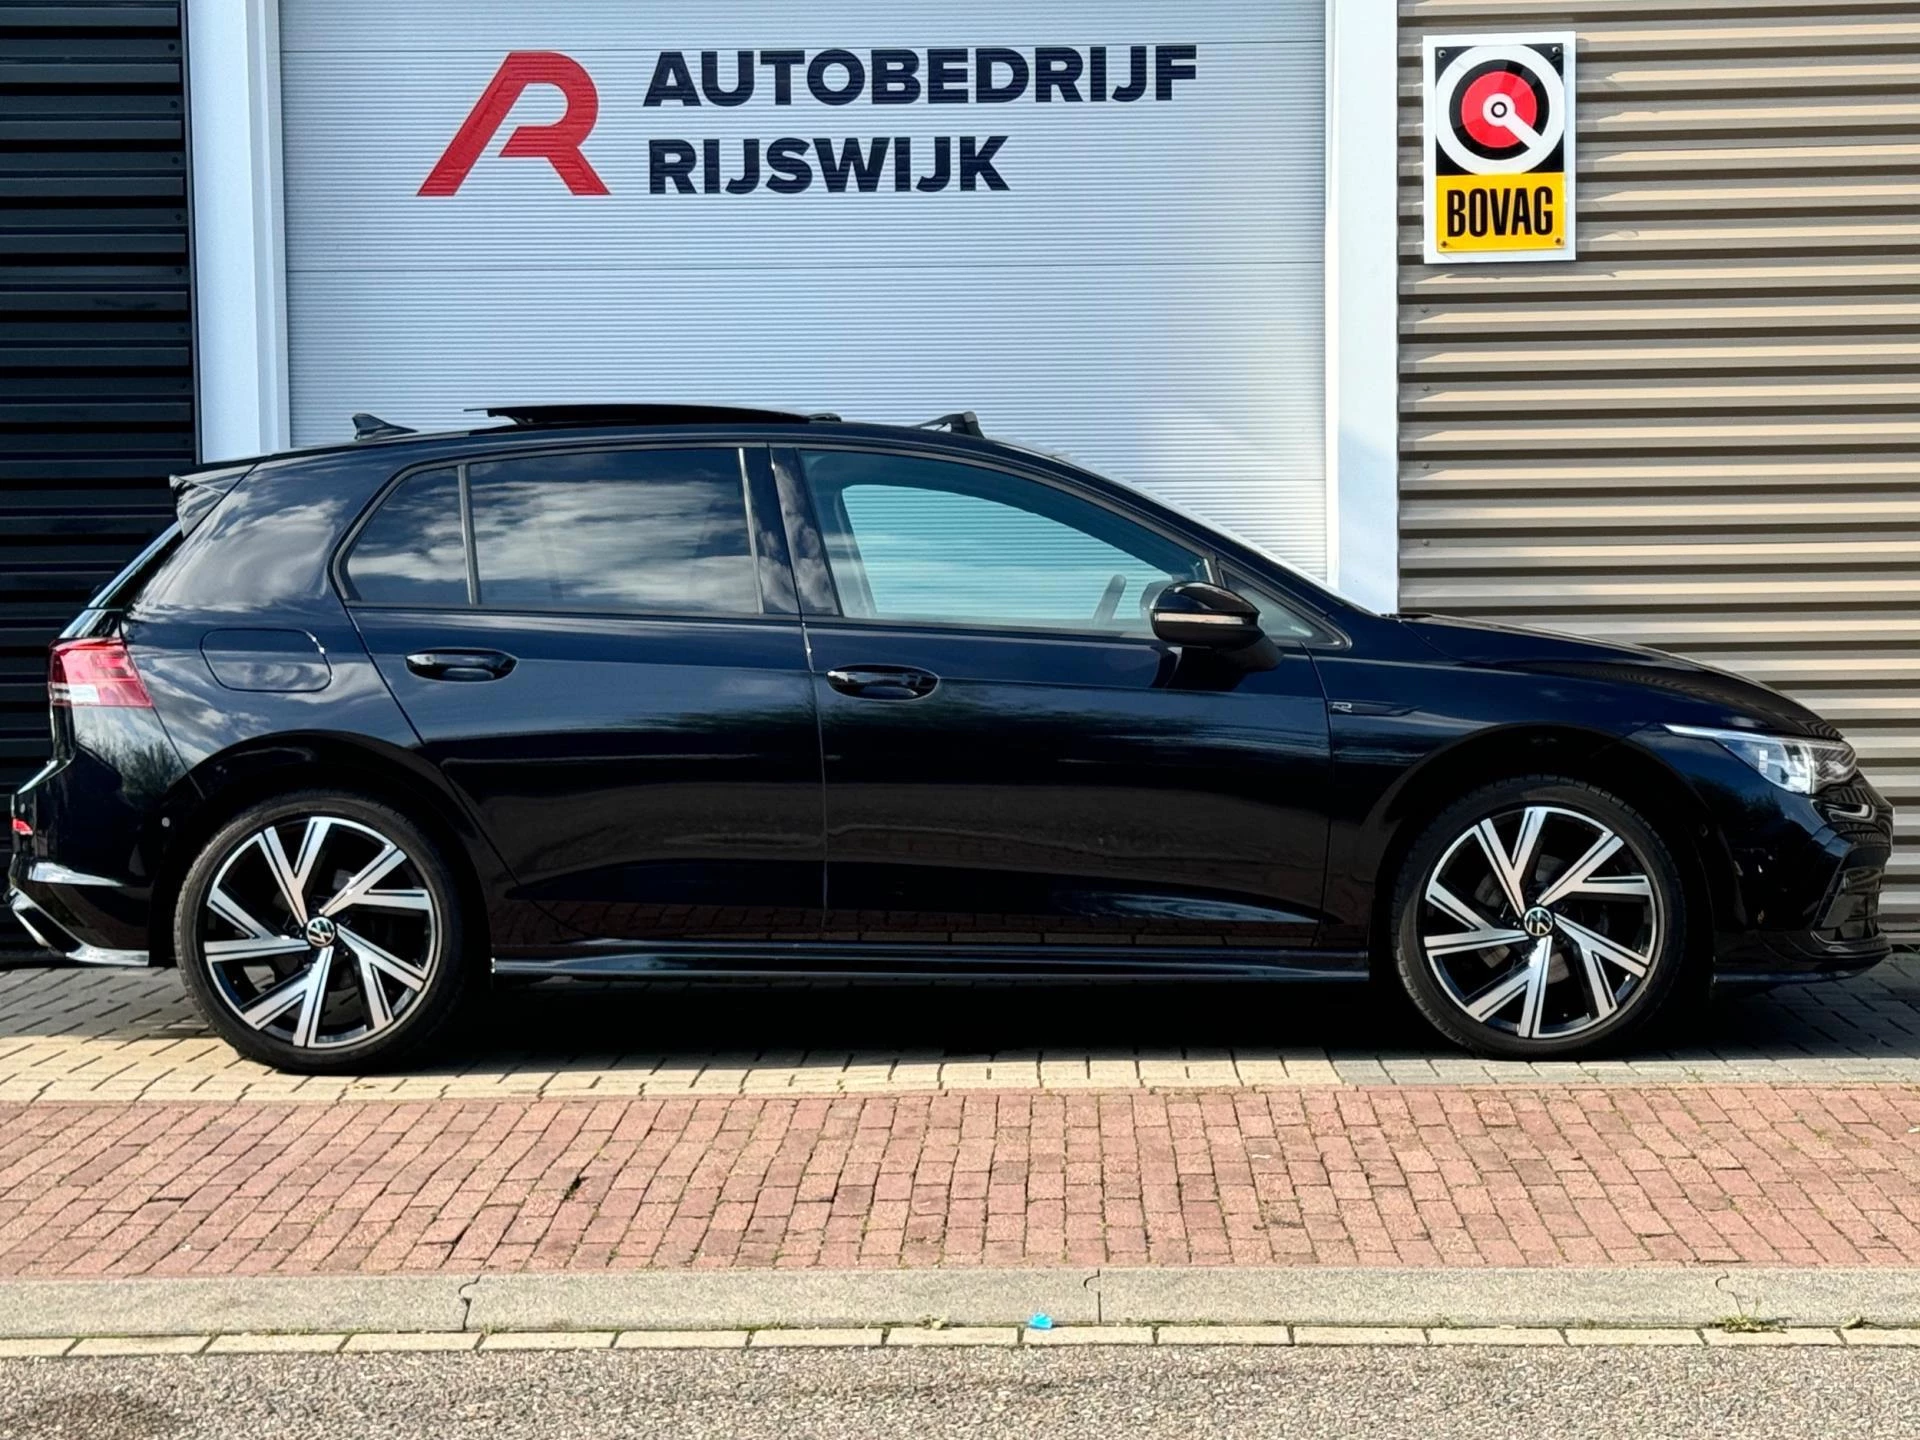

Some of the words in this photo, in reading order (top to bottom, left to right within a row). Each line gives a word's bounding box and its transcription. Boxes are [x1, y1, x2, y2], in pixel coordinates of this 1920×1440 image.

[644, 46, 1196, 106] AUTOBEDRIJF
[650, 136, 1009, 194] RIJSWIJK
[1447, 186, 1553, 237] BOVAG
